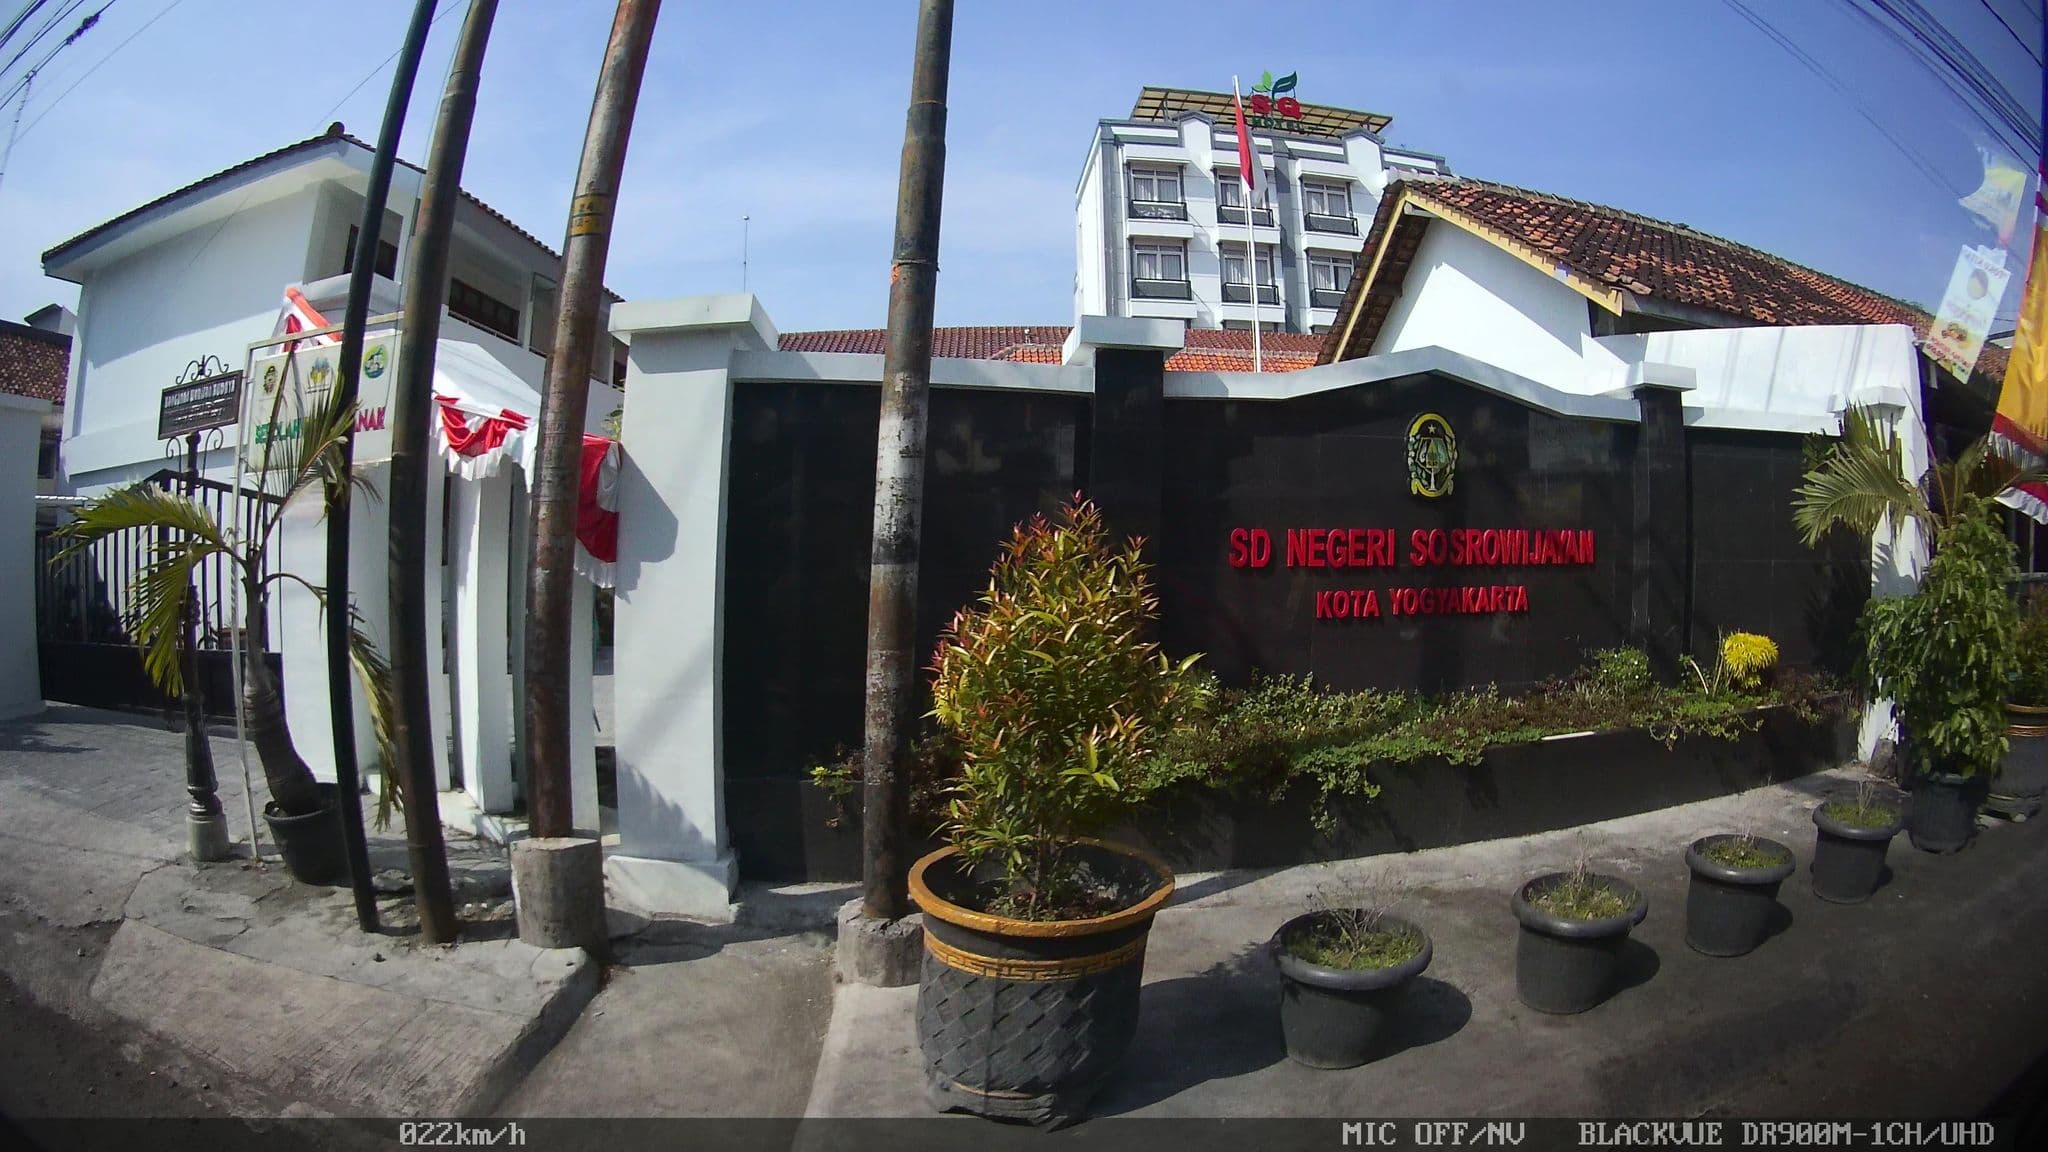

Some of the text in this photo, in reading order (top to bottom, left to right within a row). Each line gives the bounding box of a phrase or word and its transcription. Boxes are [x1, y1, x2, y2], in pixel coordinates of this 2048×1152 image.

[1252, 116, 1305, 134] HOTEL
[1229, 527, 1271, 568] SD
[1286, 528, 1396, 568] NEGERI
[1316, 585, 1529, 619] KOTA YOGYAKARTA
